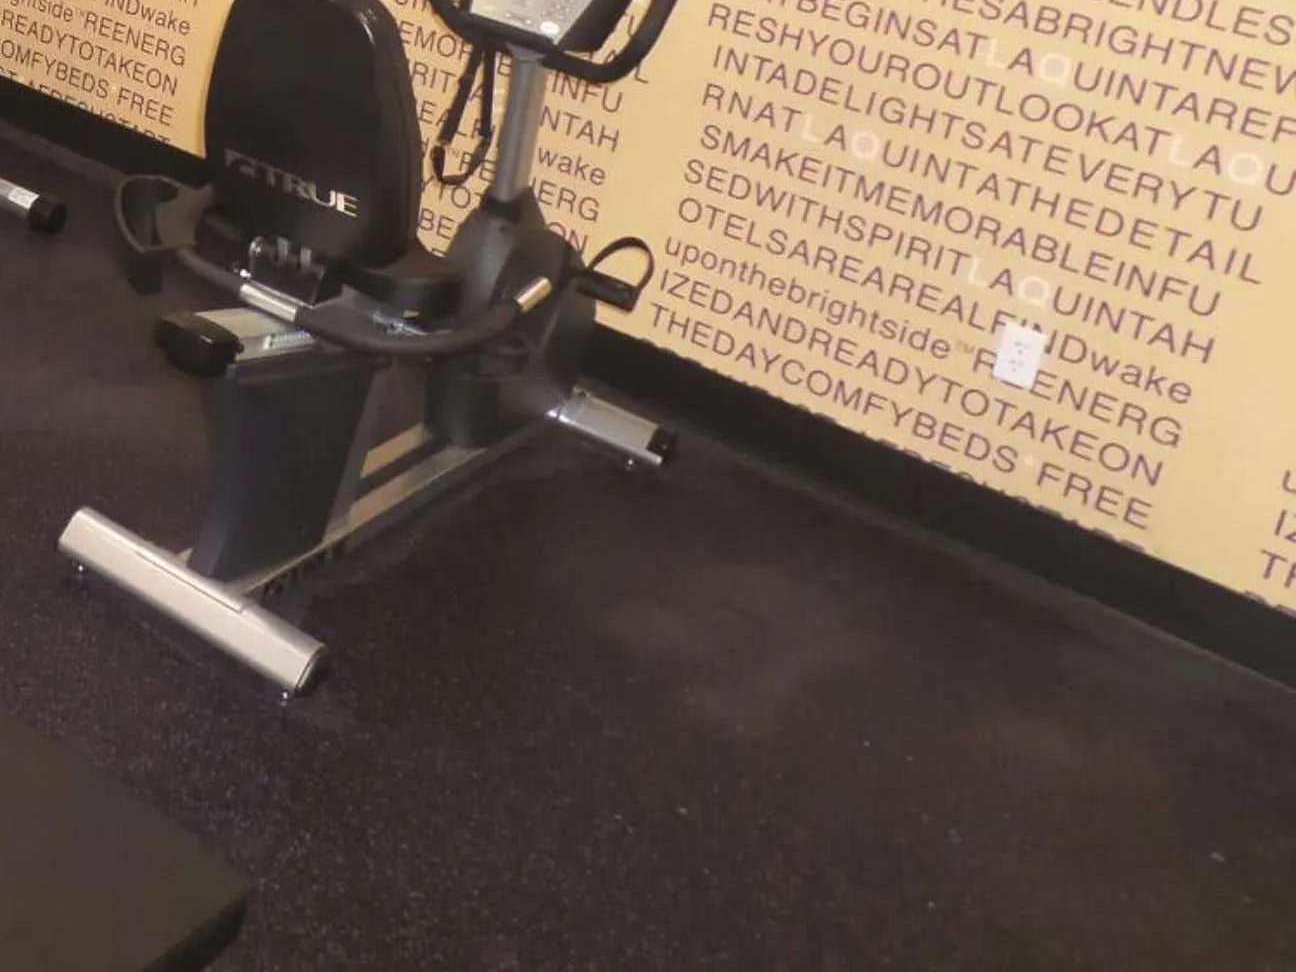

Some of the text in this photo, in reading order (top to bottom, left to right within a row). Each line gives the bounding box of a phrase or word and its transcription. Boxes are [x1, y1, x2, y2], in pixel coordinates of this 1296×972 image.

[116, 86, 175, 128] FREE
[258, 161, 360, 218] TRUE
[714, 45, 1264, 233] INTADELIGHTSATEVERYTU
[677, 199, 1193, 406] OTELSAREAREALFDwake
[700, 125, 1222, 319] SMAKEITMEMORABLEINFU
[648, 303, 1020, 475] THEDAYCOMFYBEDS
[1035, 463, 1153, 531] FREE
[659, 270, 1164, 488] IZEDANDREADYTOTAKEON
